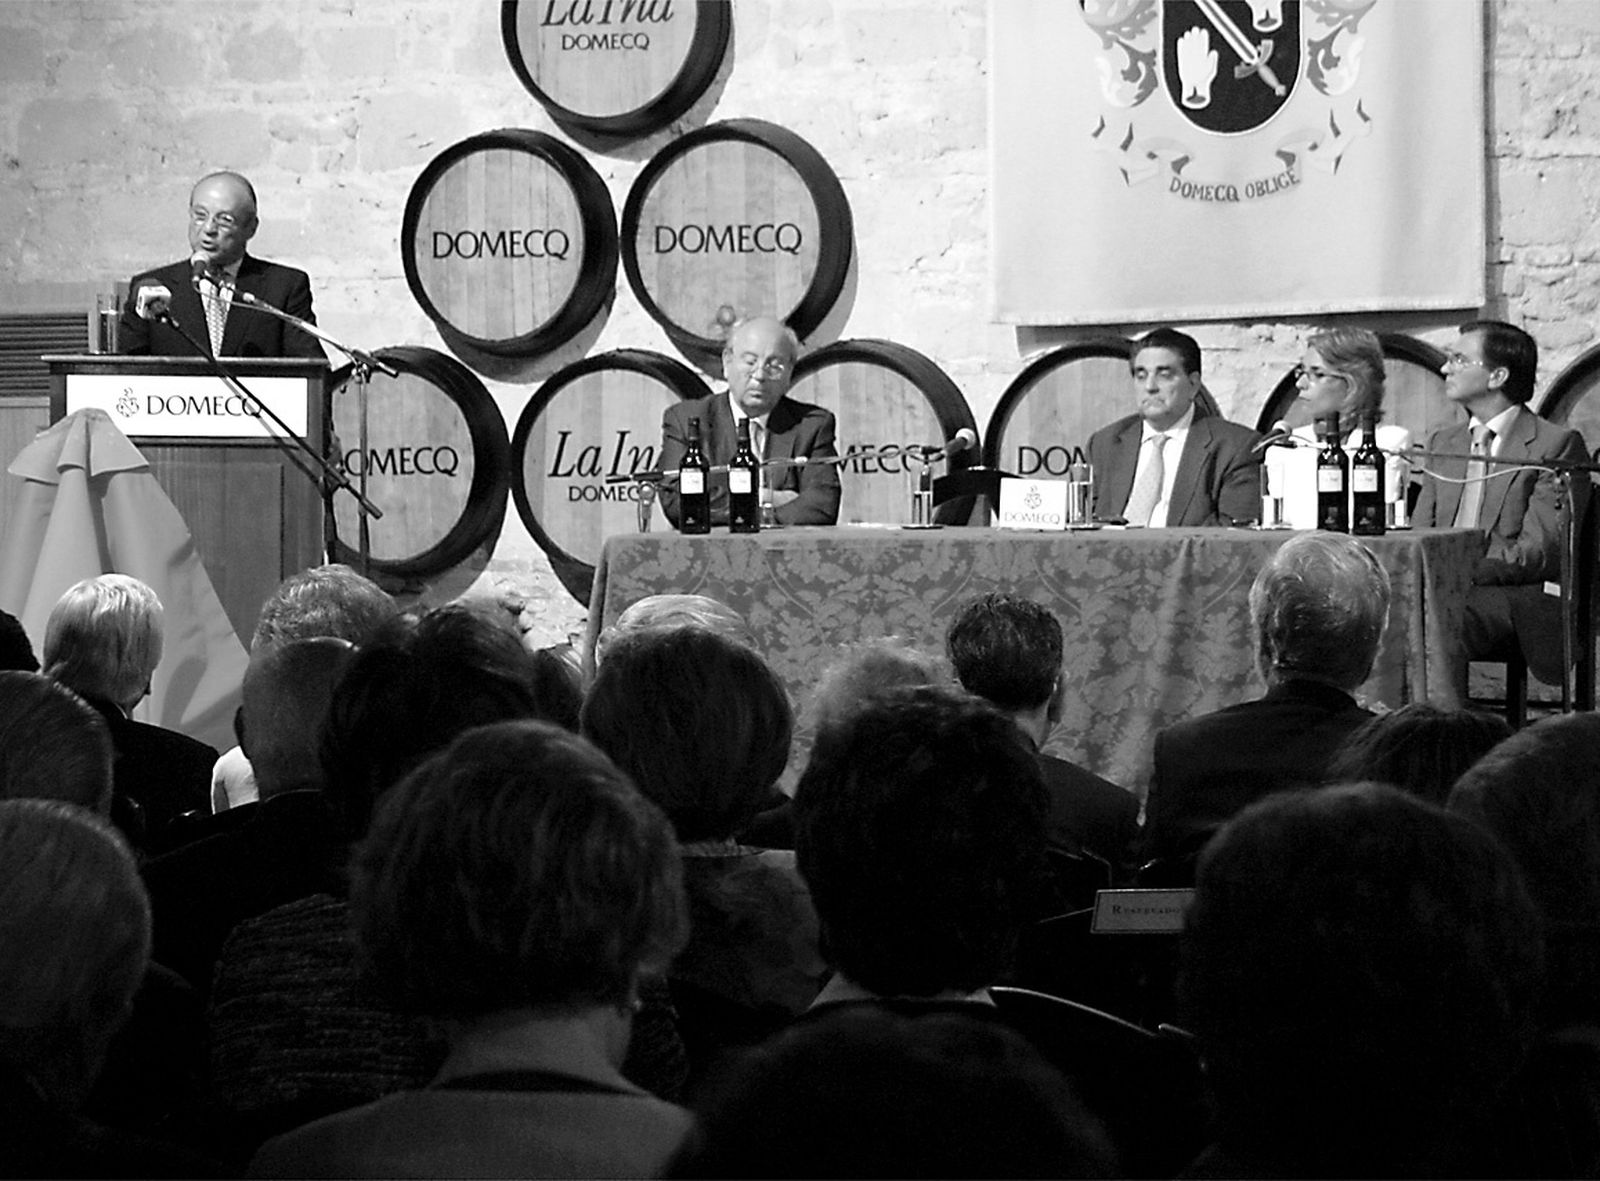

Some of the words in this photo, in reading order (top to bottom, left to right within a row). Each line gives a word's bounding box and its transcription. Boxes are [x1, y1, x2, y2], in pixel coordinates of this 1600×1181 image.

[562, 33, 650, 51] DOMECQ
[1169, 176, 1240, 202] DOMECQ
[433, 230, 570, 260] DOMECQ
[654, 223, 803, 255] DOMECQ
[146, 394, 263, 418] DOMECQ
[344, 446, 459, 477] OMECQ
[547, 430, 602, 478] La
[605, 430, 661, 478] In
[568, 485, 640, 502] DOMEC
[1004, 511, 1061, 525] DOMECQ
